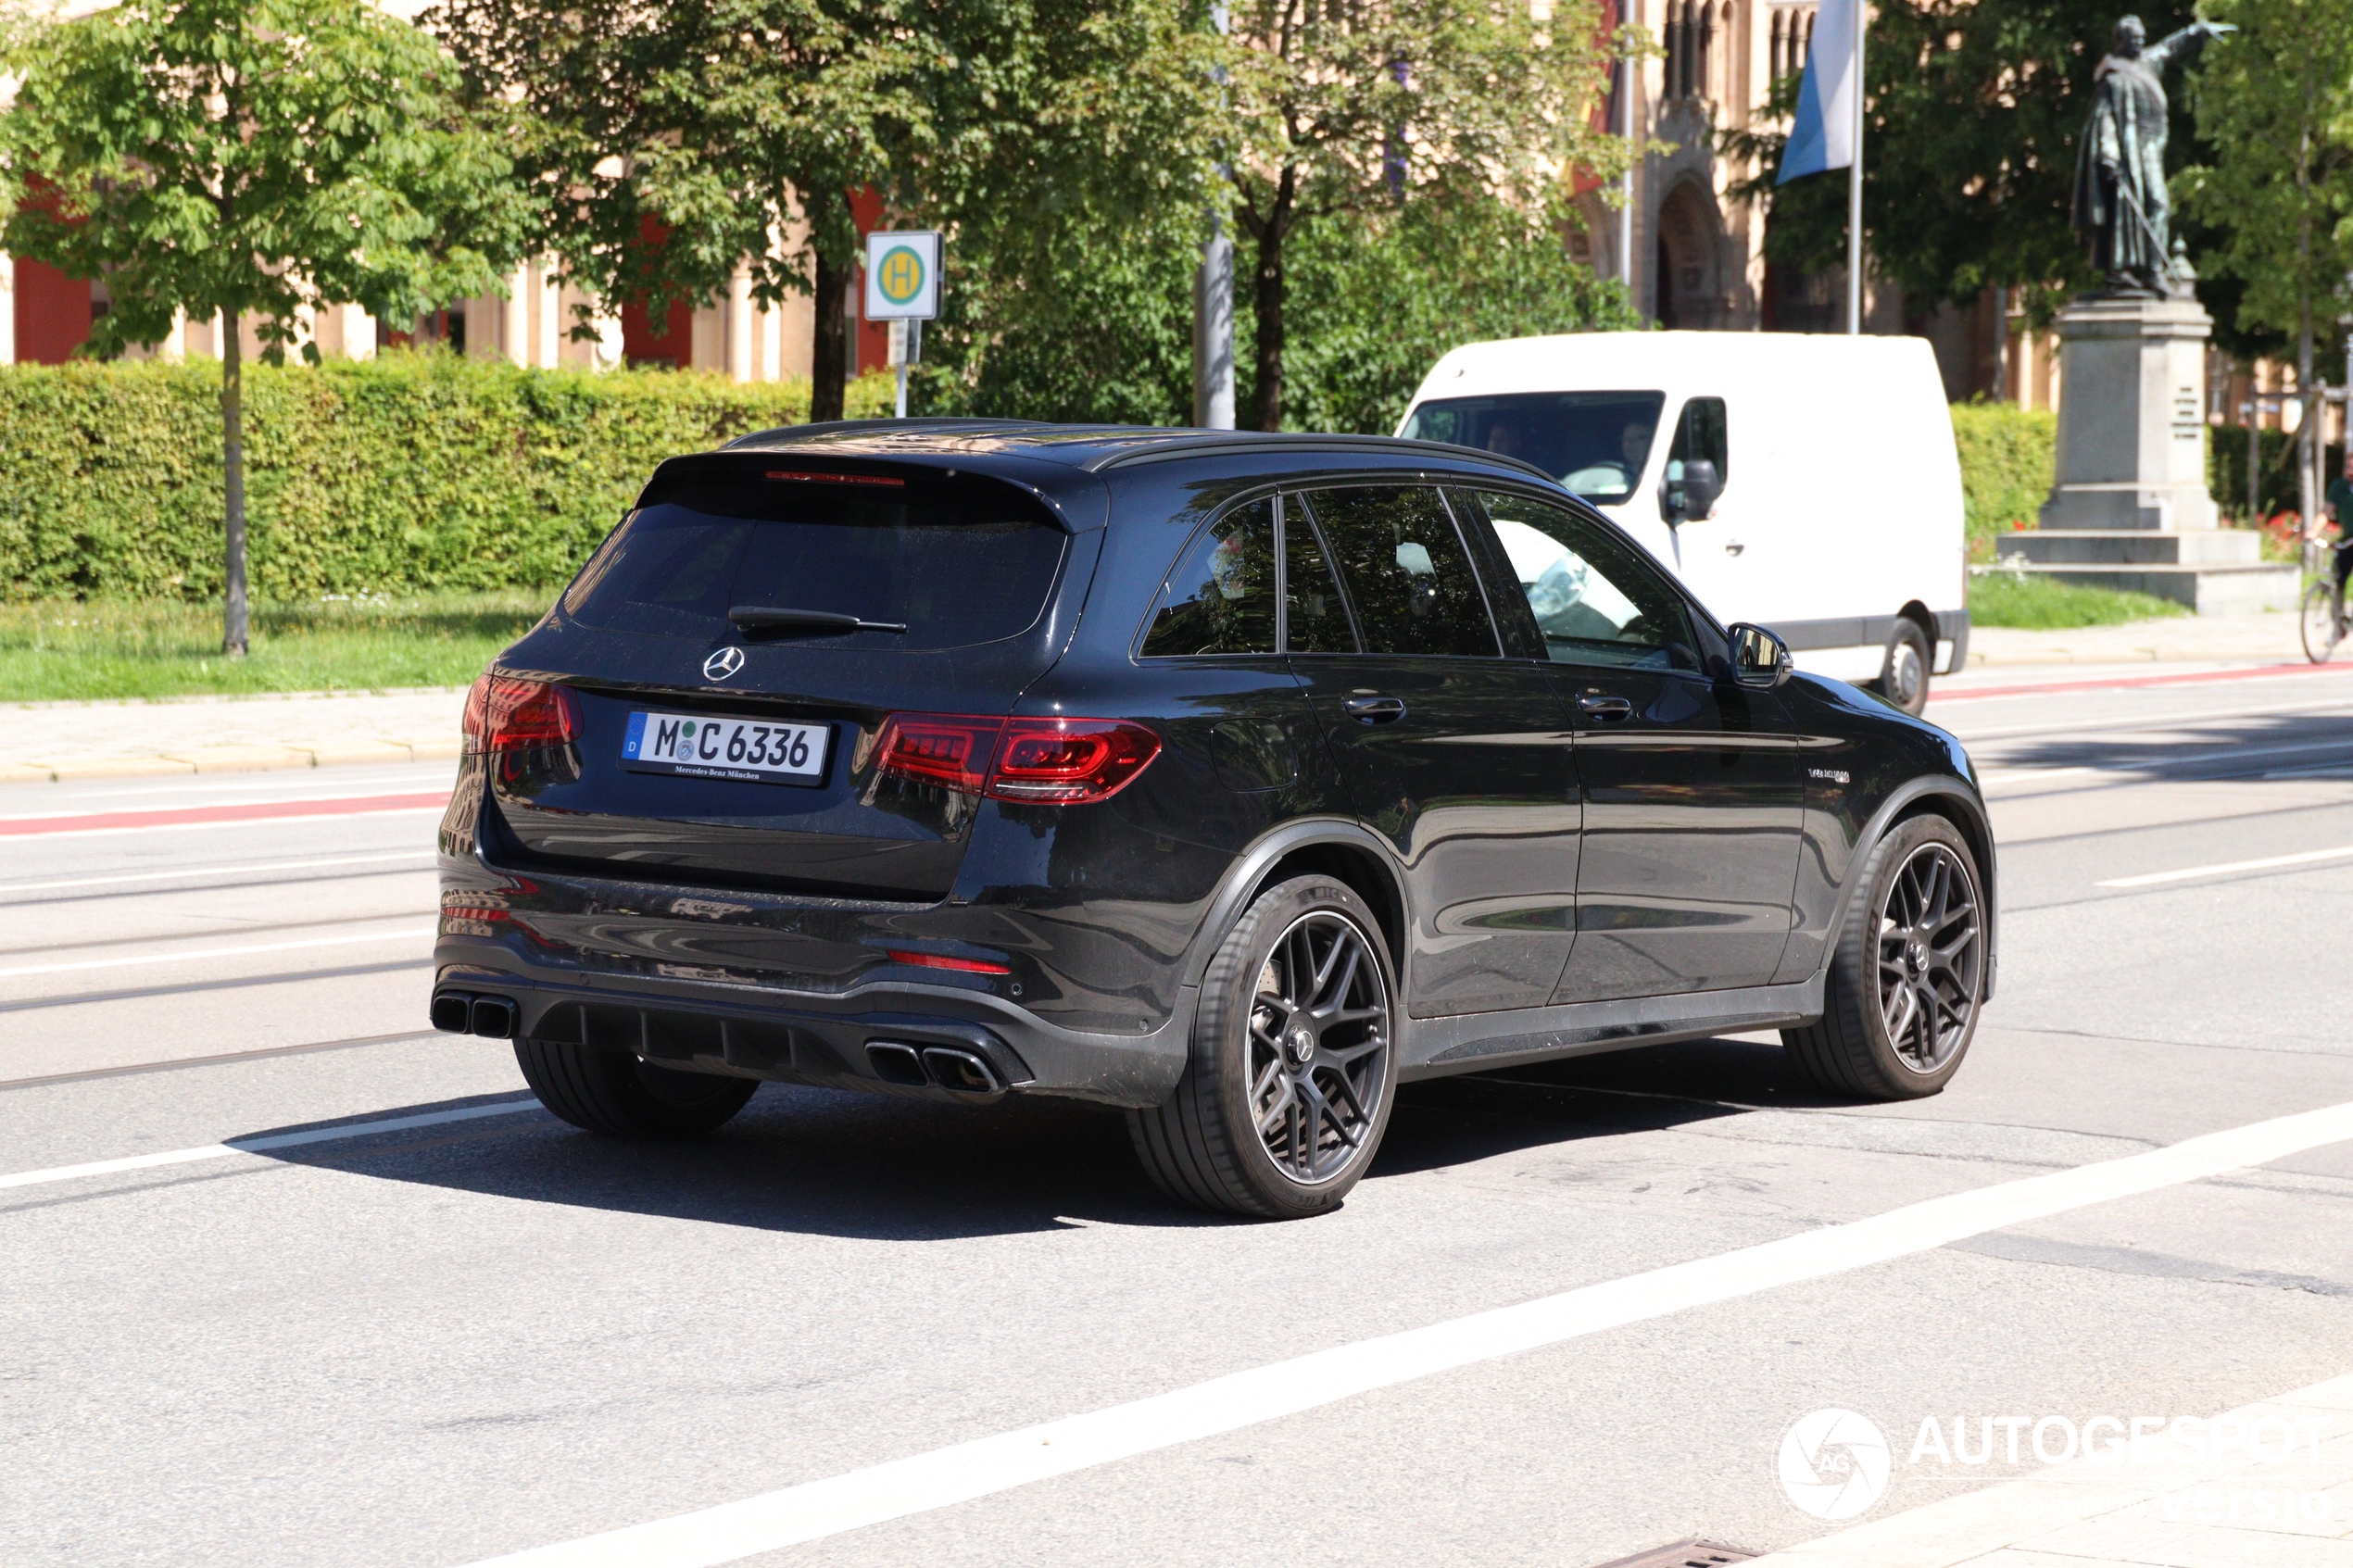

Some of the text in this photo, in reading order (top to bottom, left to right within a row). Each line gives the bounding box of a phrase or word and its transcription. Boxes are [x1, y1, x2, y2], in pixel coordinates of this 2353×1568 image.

[891, 259, 912, 292] H
[627, 741, 636, 752] D
[654, 719, 809, 768] M C 6336
[674, 765, 760, 780] Mercedes-Benz München
